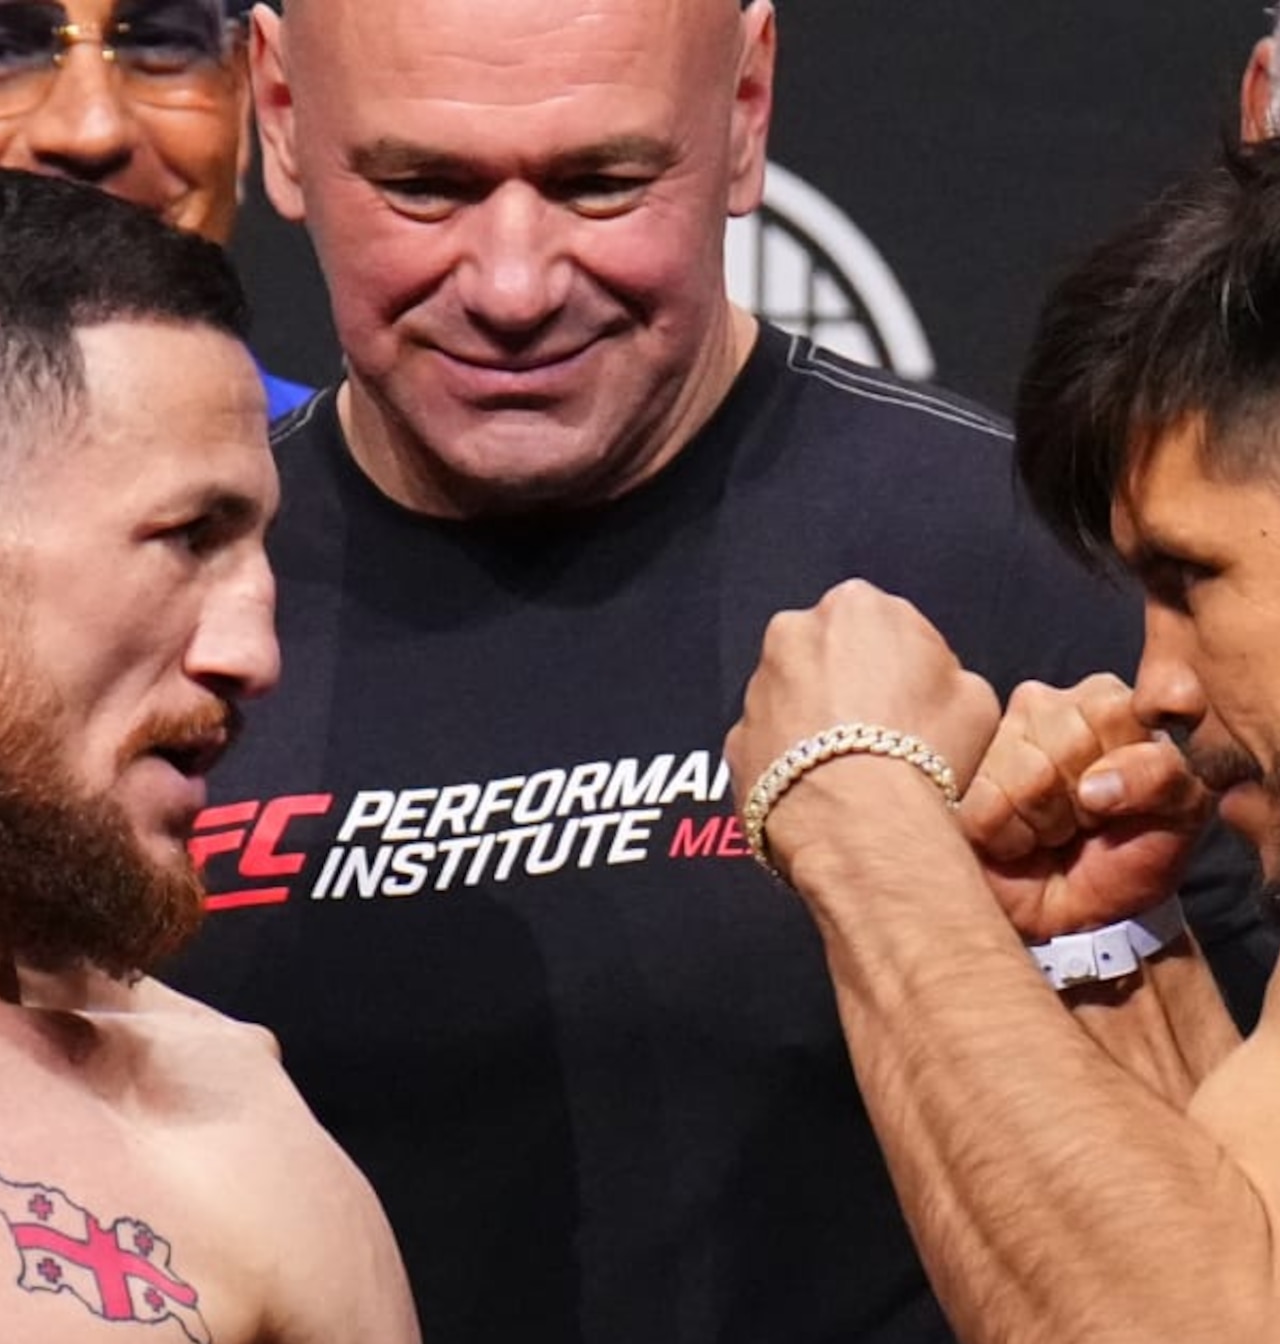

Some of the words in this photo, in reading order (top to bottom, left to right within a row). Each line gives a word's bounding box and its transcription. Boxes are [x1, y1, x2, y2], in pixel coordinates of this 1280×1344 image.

[186, 792, 333, 878] FC
[311, 808, 661, 900] INSTITUTE
[668, 815, 754, 859] ME
